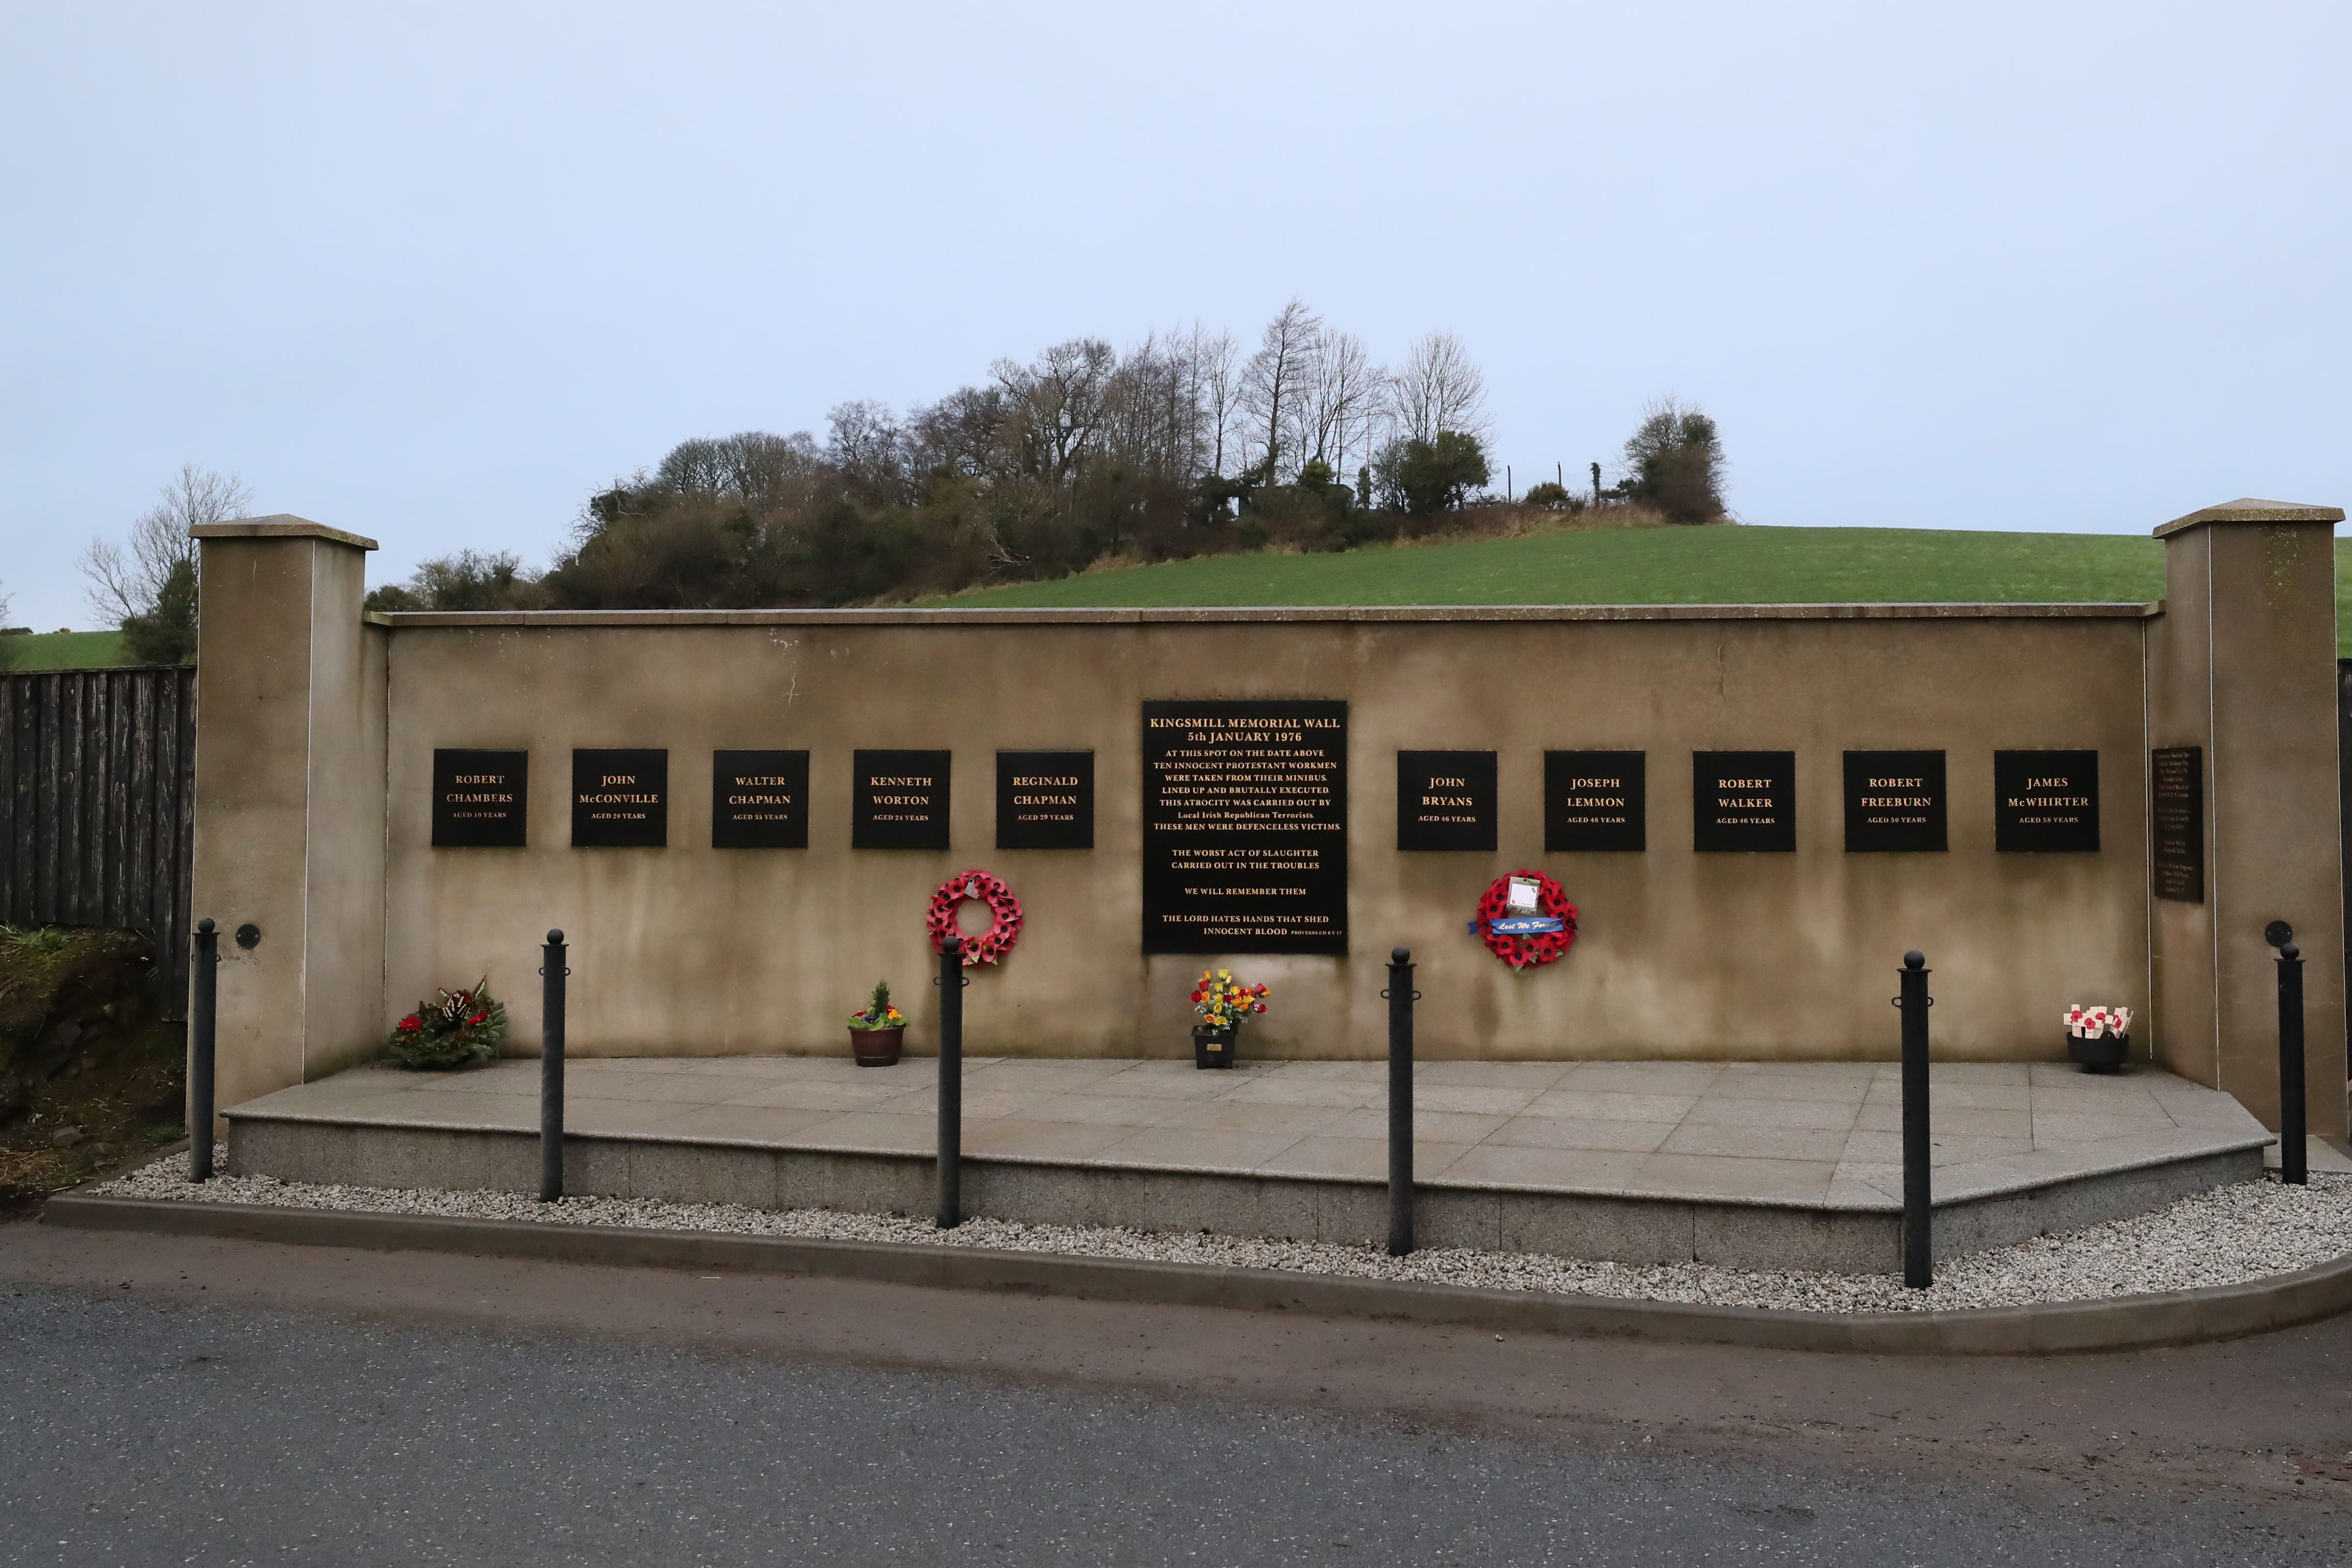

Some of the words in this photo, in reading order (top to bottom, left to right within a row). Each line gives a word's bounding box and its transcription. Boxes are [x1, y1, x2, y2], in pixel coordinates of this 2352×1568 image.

[1150, 718, 1225, 728] KINGSMILL
[1228, 719, 1301, 728] MEMORIAL
[1303, 718, 1340, 728] WALL
[1188, 732, 1206, 741] 5th
[1208, 732, 1271, 744] JANUARY
[1275, 732, 1302, 742] 1976
[455, 775, 505, 784] ROBERT
[601, 775, 636, 787] JOHN
[735, 777, 785, 786] WALTER
[870, 777, 932, 786] KENNETH
[1012, 777, 1078, 786] REGINALD
[1428, 777, 1465, 789] JOHN
[1570, 778, 1620, 790] JOSEPH
[1718, 779, 1772, 788] ROBERT
[1868, 778, 1923, 787] ROBERT
[2026, 778, 2068, 790] JAMES
[446, 794, 513, 802] CHAMBERS
[579, 794, 658, 803] McCONVILLE
[729, 795, 791, 804] CHAPMAN
[872, 795, 929, 805] WORTON
[1013, 795, 1076, 804] CHAPMAN
[1422, 796, 1473, 806] BRYANS
[1567, 797, 1625, 807] LEMMON
[1718, 798, 1773, 808] WALKER
[1861, 797, 1932, 807] FREEBURN
[2008, 797, 2089, 807] McWHIRTER
[1224, 811, 1270, 820] Republican
